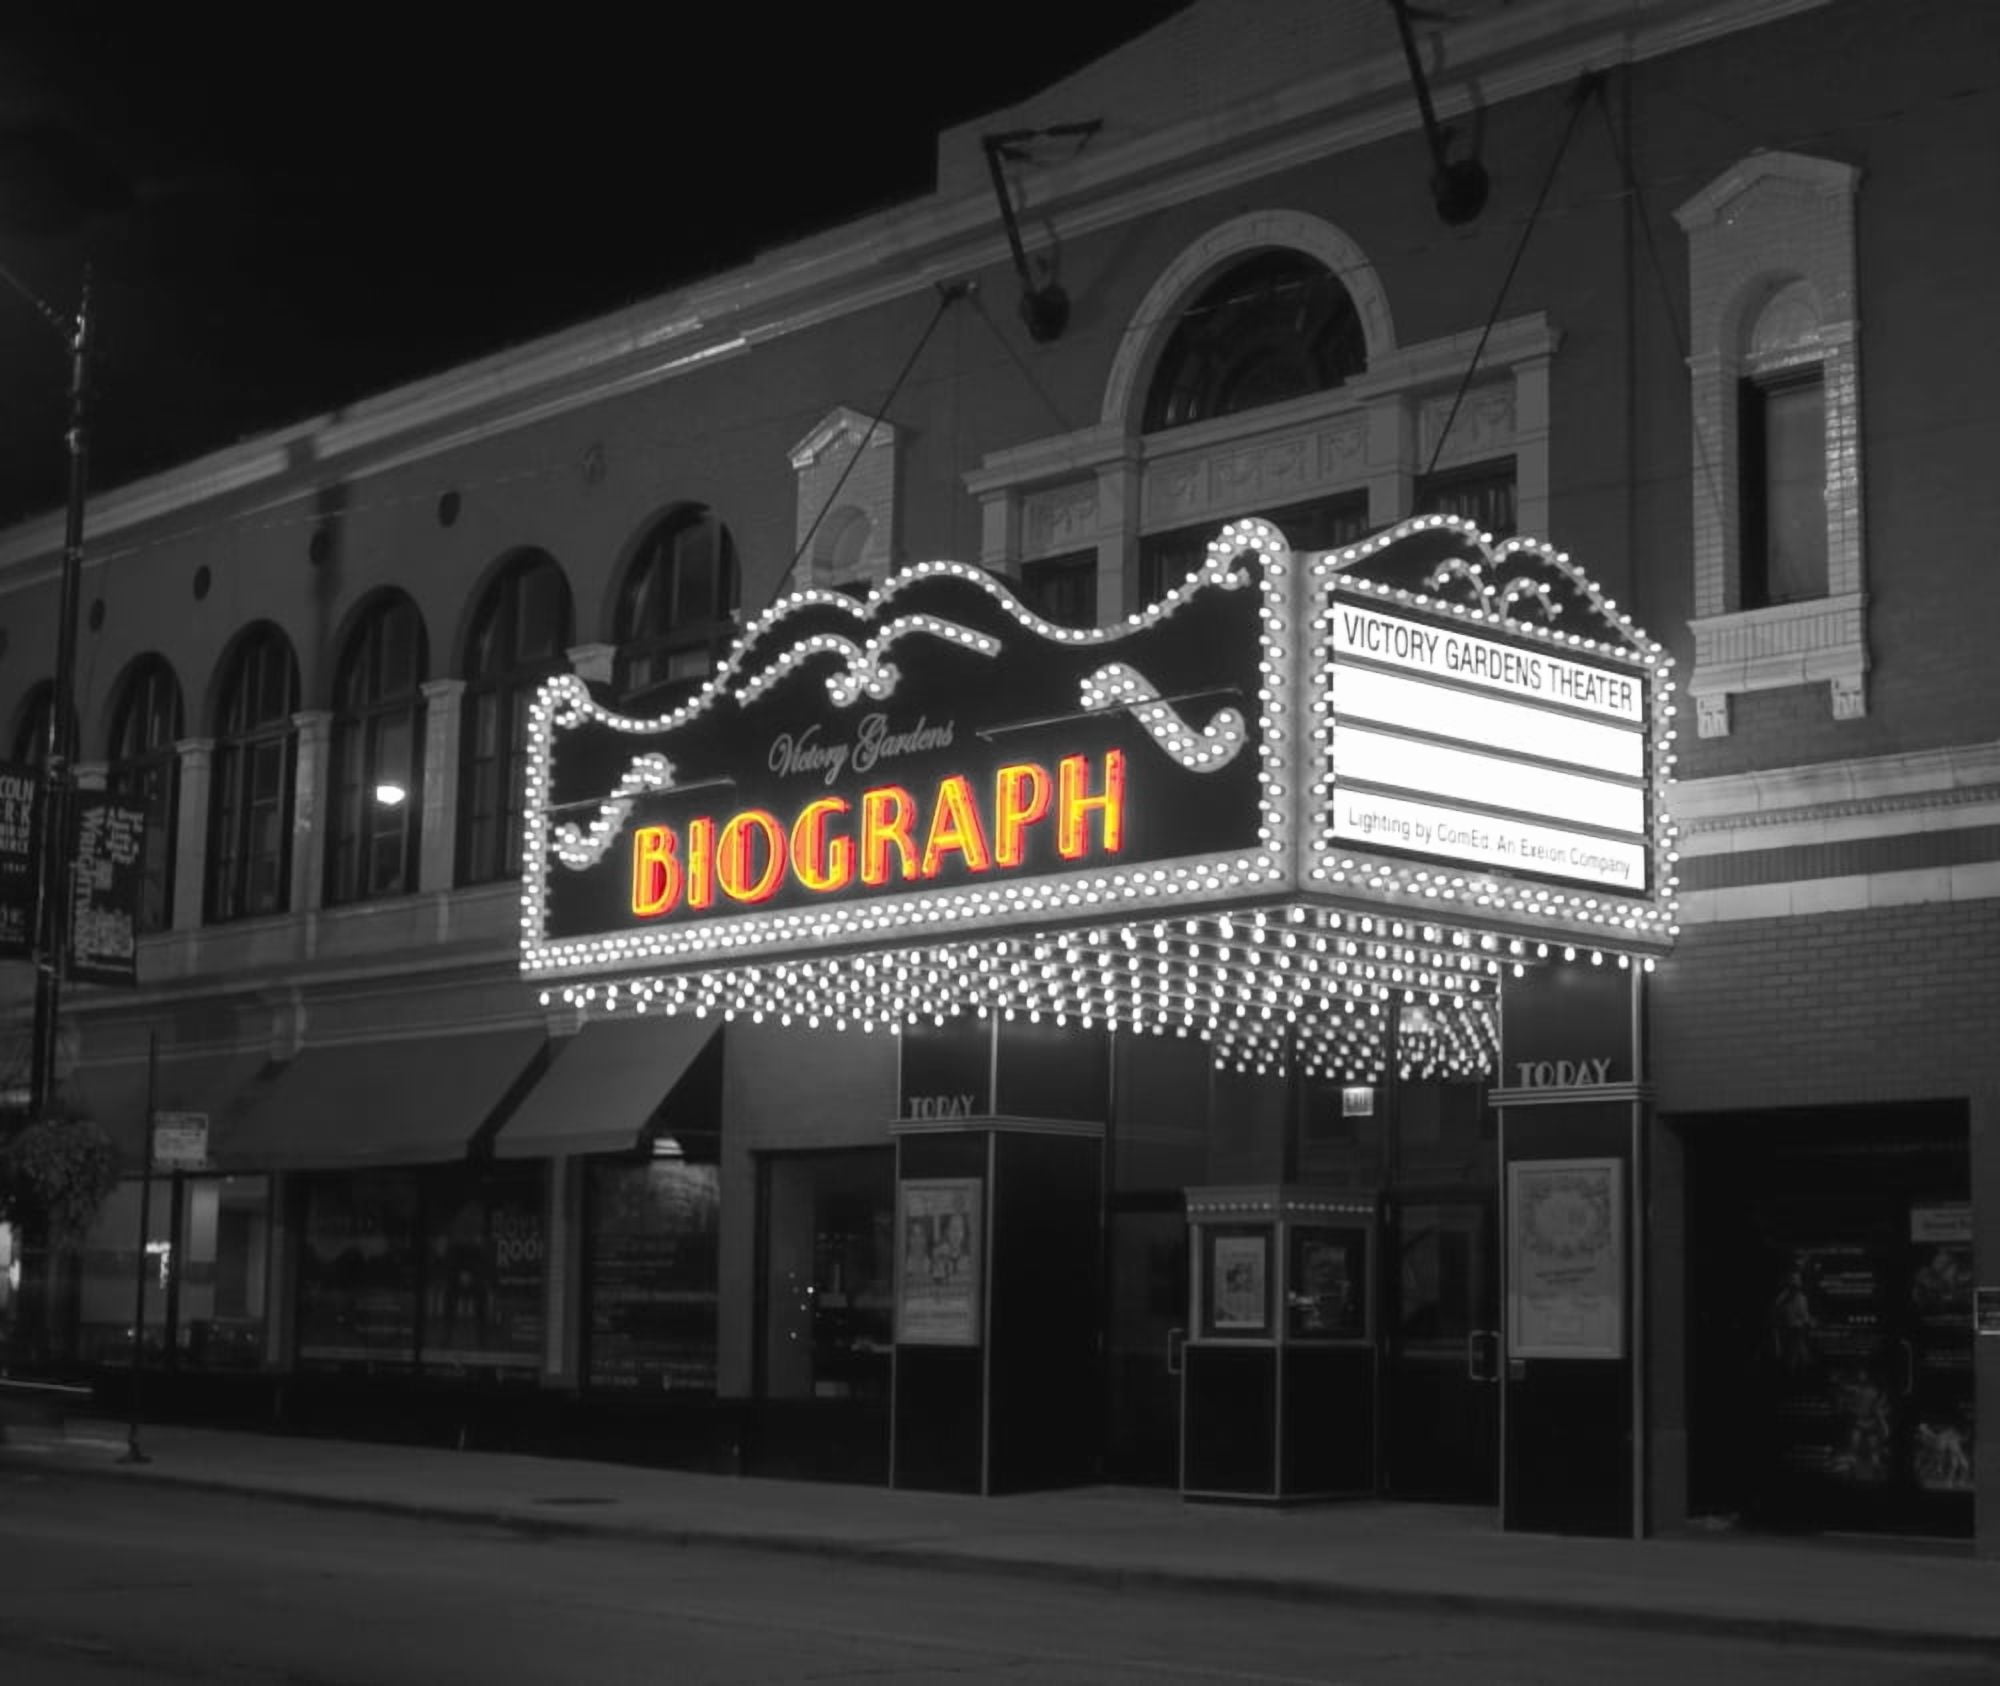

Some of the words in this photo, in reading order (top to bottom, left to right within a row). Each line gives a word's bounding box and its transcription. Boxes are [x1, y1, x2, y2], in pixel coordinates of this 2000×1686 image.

[1343, 611, 1440, 666] VICTORY
[1445, 639, 1542, 690] GARDENS
[1547, 663, 1633, 712] THEATER
[767, 722, 850, 786] Victory
[850, 712, 956, 773] Gardens
[630, 748, 1127, 919] BIOGRAPH
[1348, 806, 1411, 840] Lighting
[1415, 816, 1433, 843] by
[1496, 833, 1517, 855] An
[1569, 847, 1632, 880] Company
[908, 1093, 976, 1121] TODAY
[1515, 1056, 1612, 1088] TODAY
